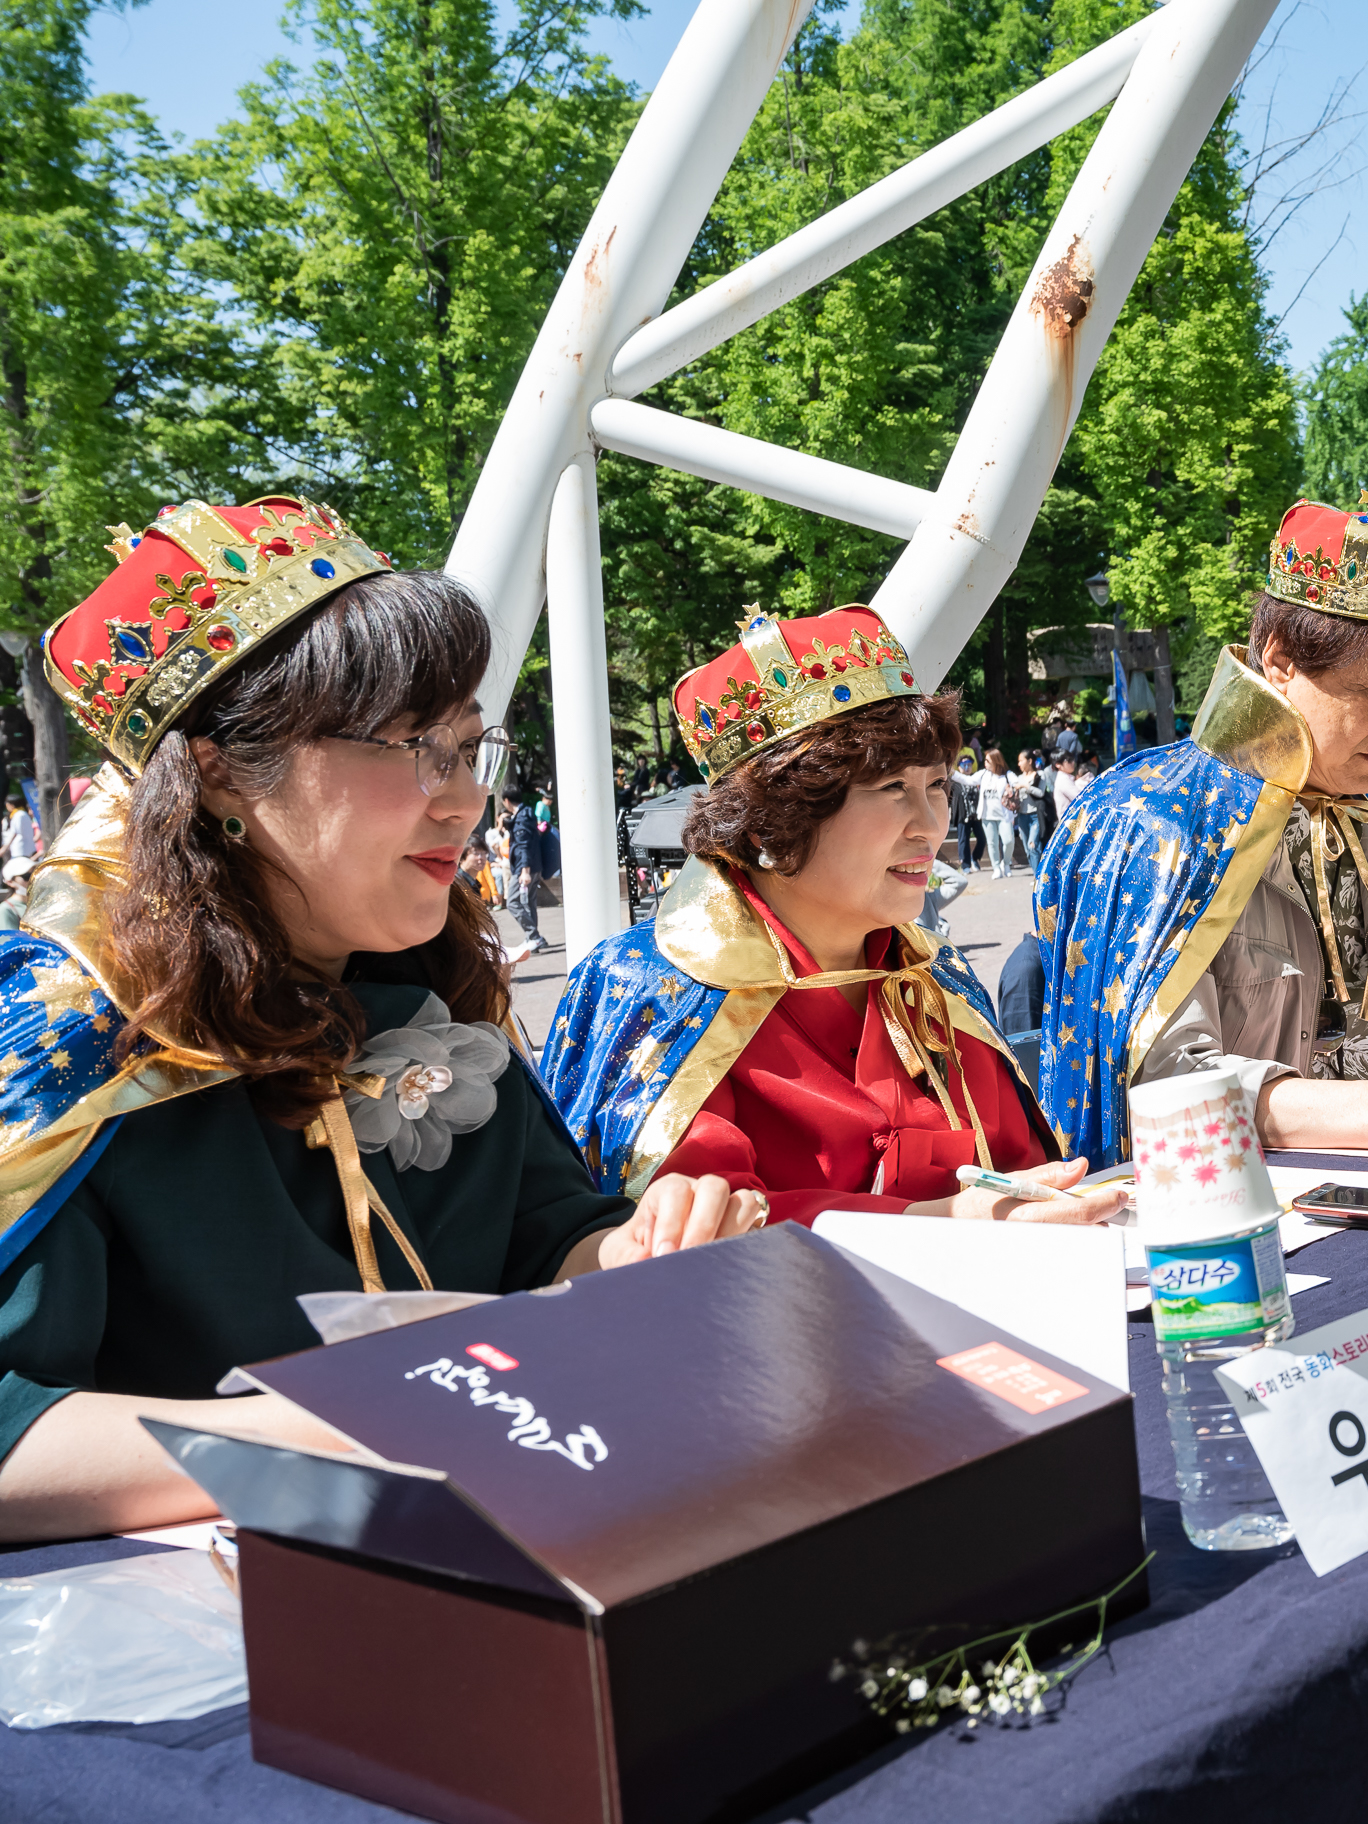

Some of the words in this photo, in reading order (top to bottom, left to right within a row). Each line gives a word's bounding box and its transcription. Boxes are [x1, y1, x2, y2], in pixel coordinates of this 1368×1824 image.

[1163, 1260, 1235, 1291] 삼다수
[1244, 1381, 1280, 1404] 제5회
[1278, 1366, 1306, 1390] 전국
